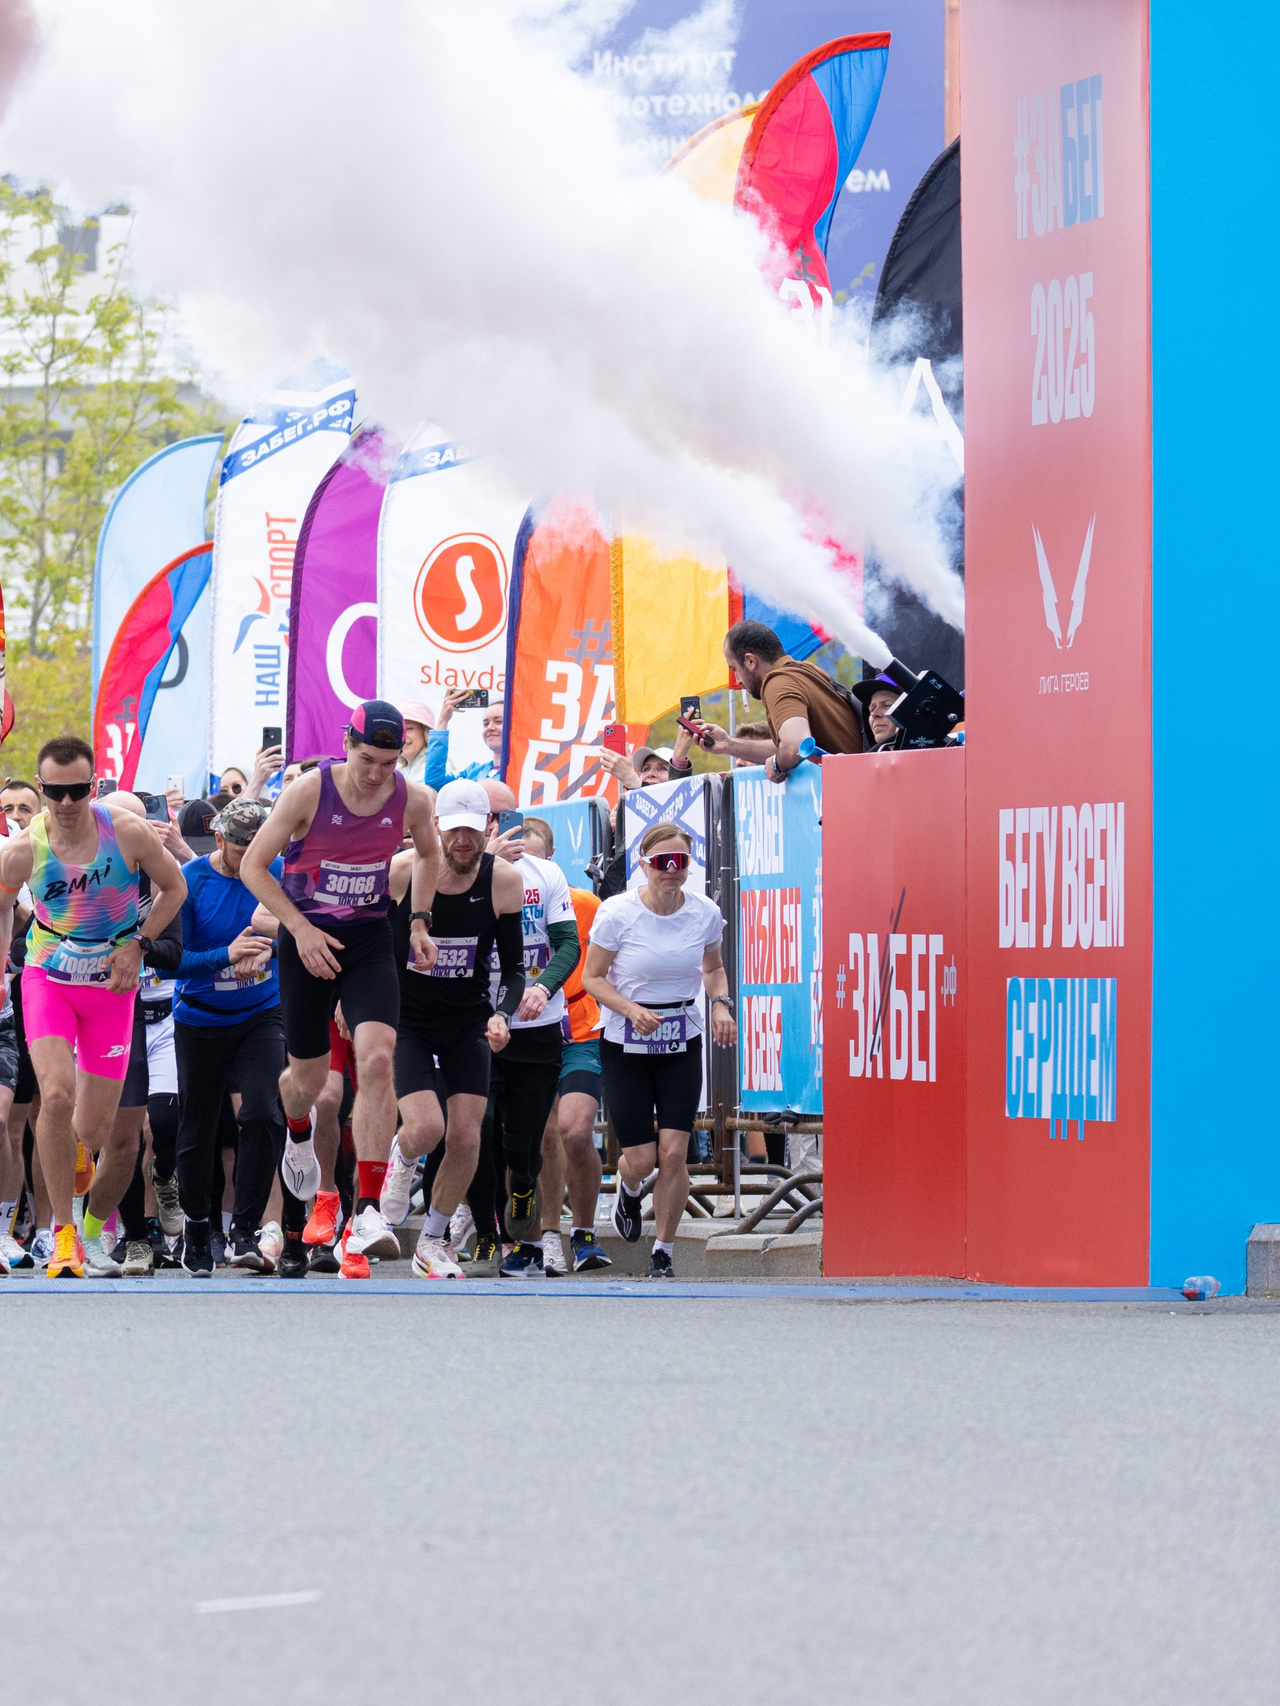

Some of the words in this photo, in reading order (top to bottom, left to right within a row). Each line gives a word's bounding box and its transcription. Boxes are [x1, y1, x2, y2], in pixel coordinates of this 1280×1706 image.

[1014, 74, 1105, 240] #ЗАБЕГ
[1031, 272, 1095, 426] 2025
[240, 399, 352, 467] ЗАБЕГ.РФ
[265, 511, 297, 599] СПОРТ
[254, 644, 281, 706] НАШ
[420, 659, 506, 692] slavda
[1038, 675, 1059, 694] ЛИГА
[1061, 672, 1089, 692] ГЕРОЕВ
[518, 738, 635, 808] БЕ
[326, 874, 376, 894] 30168
[999, 806, 1058, 949] БЕГУ
[1062, 802, 1125, 950] ВСЕМ
[98, 973, 107, 981] A
[437, 949, 468, 966] 532
[670, 1041, 677, 1049] A
[1005, 976, 1118, 1140] СЕРДЦЕМ
